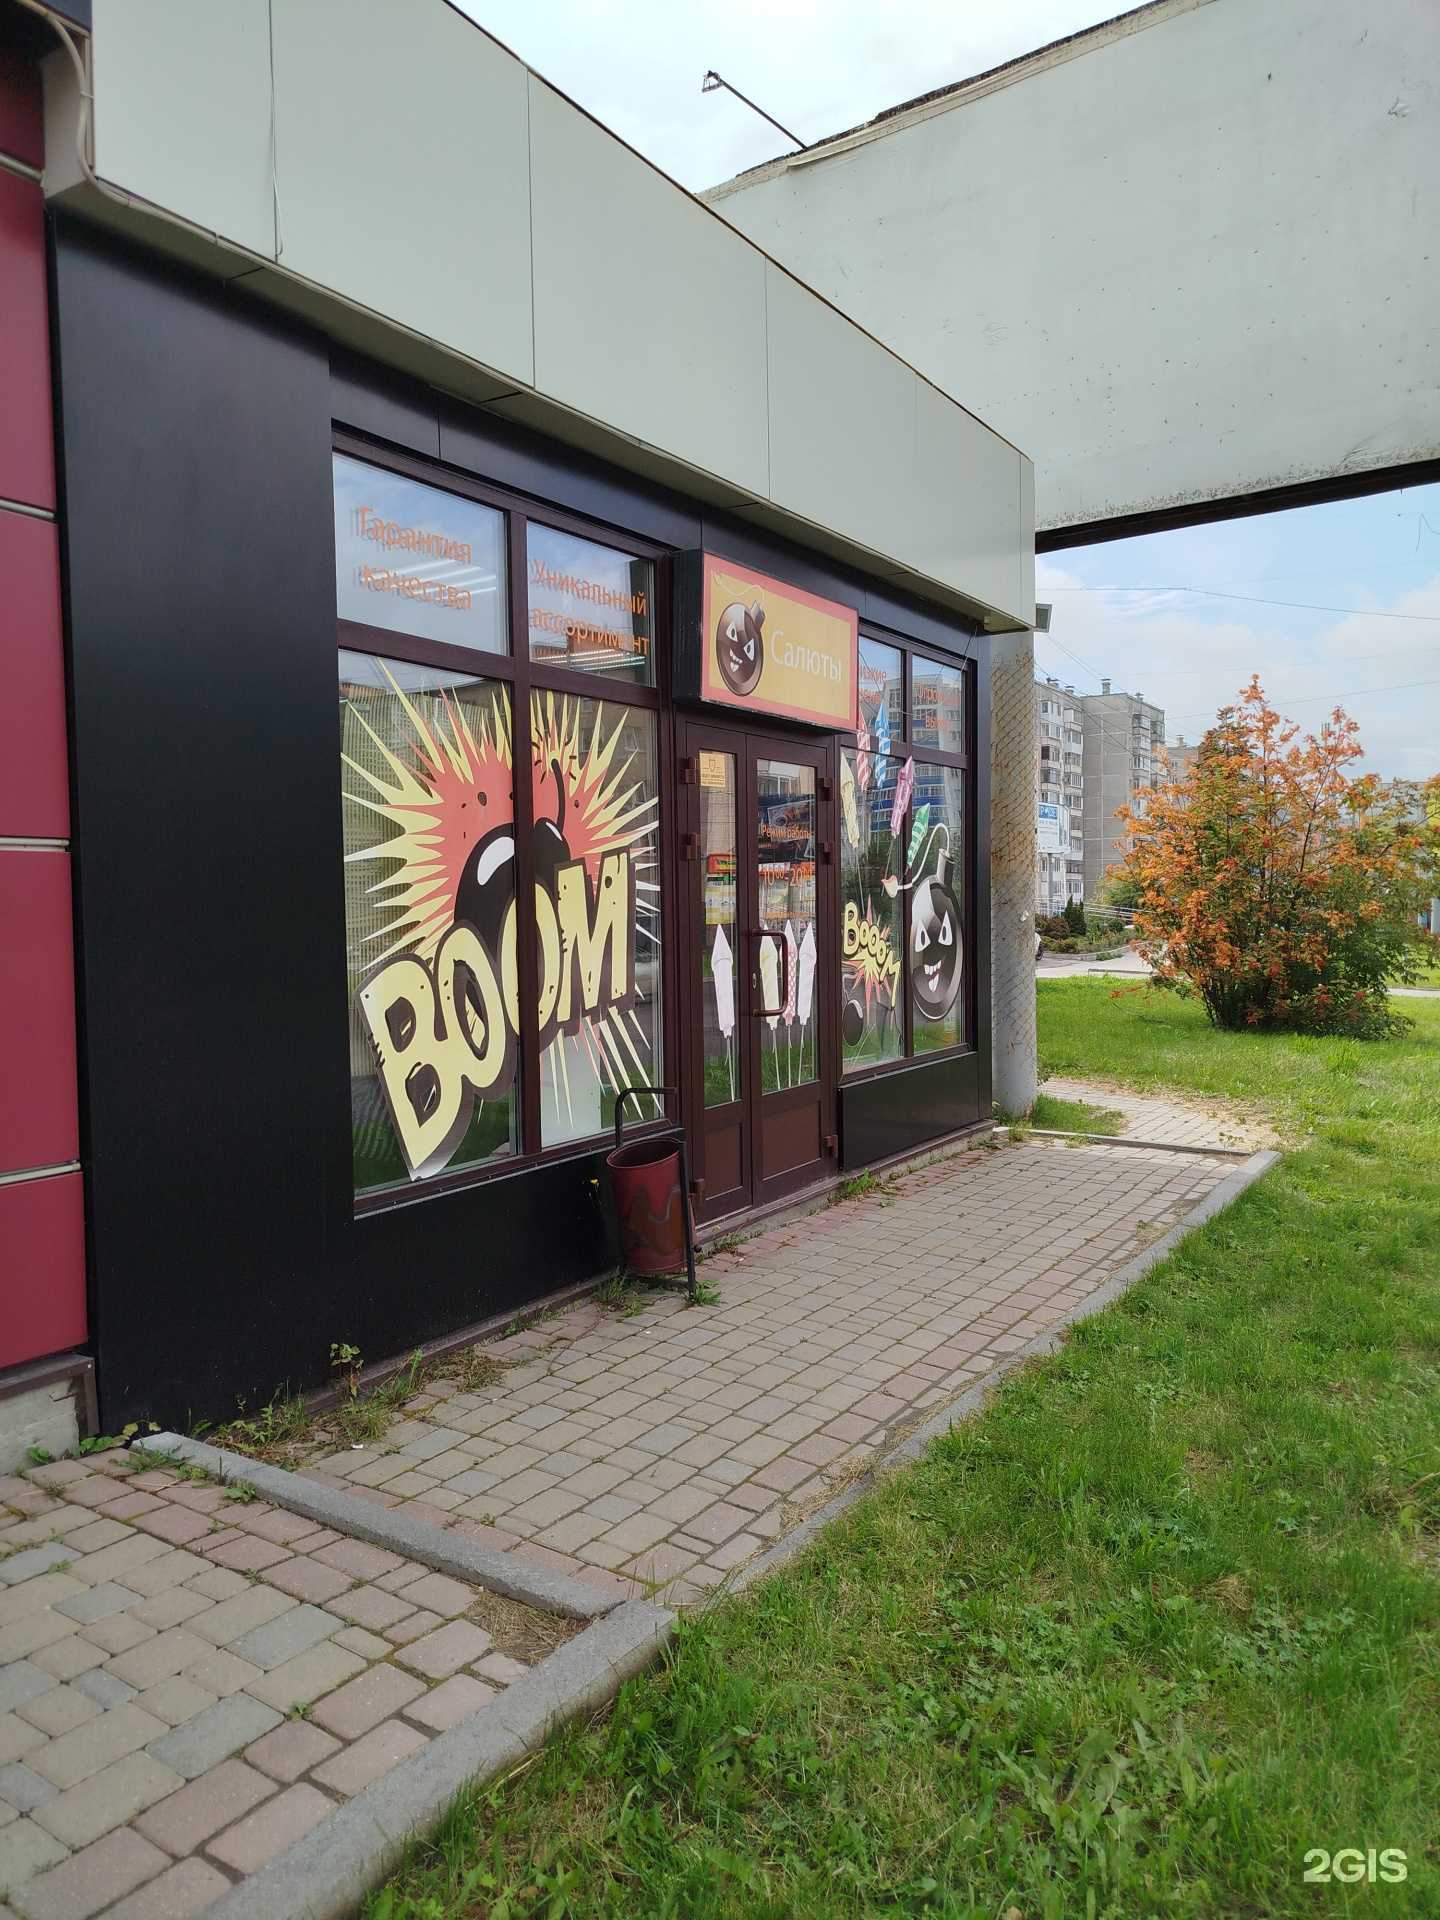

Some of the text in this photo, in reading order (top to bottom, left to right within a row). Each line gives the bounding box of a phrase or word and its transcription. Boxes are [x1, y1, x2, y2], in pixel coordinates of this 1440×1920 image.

[356, 506, 473, 564] Гарантия
[359, 565, 473, 610] качества
[533, 559, 647, 616] Уникальный
[770, 629, 842, 681] Салюты
[357, 846, 636, 1178] BOOM
